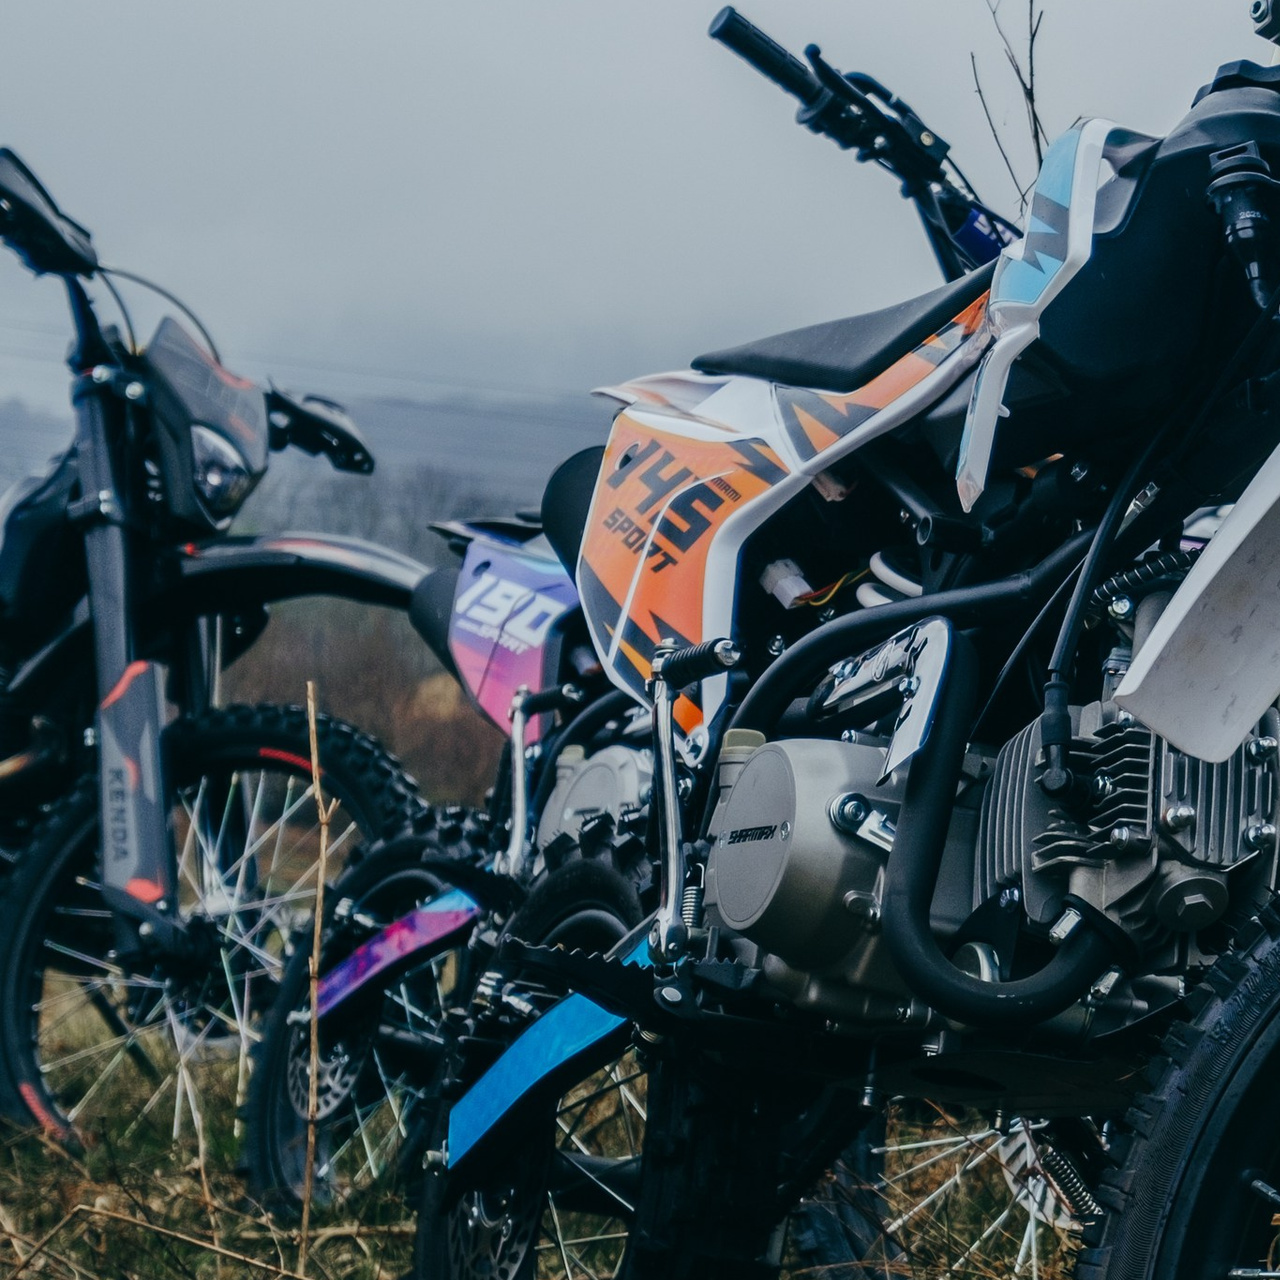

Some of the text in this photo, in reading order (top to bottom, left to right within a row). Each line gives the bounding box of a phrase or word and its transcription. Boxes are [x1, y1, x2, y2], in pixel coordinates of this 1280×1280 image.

[606, 438, 725, 554] 145
[602, 507, 679, 574] SPORT
[455, 572, 567, 648] 190
[108, 767, 128, 862] KENDA
[727, 824, 778, 845] SHARMAX
